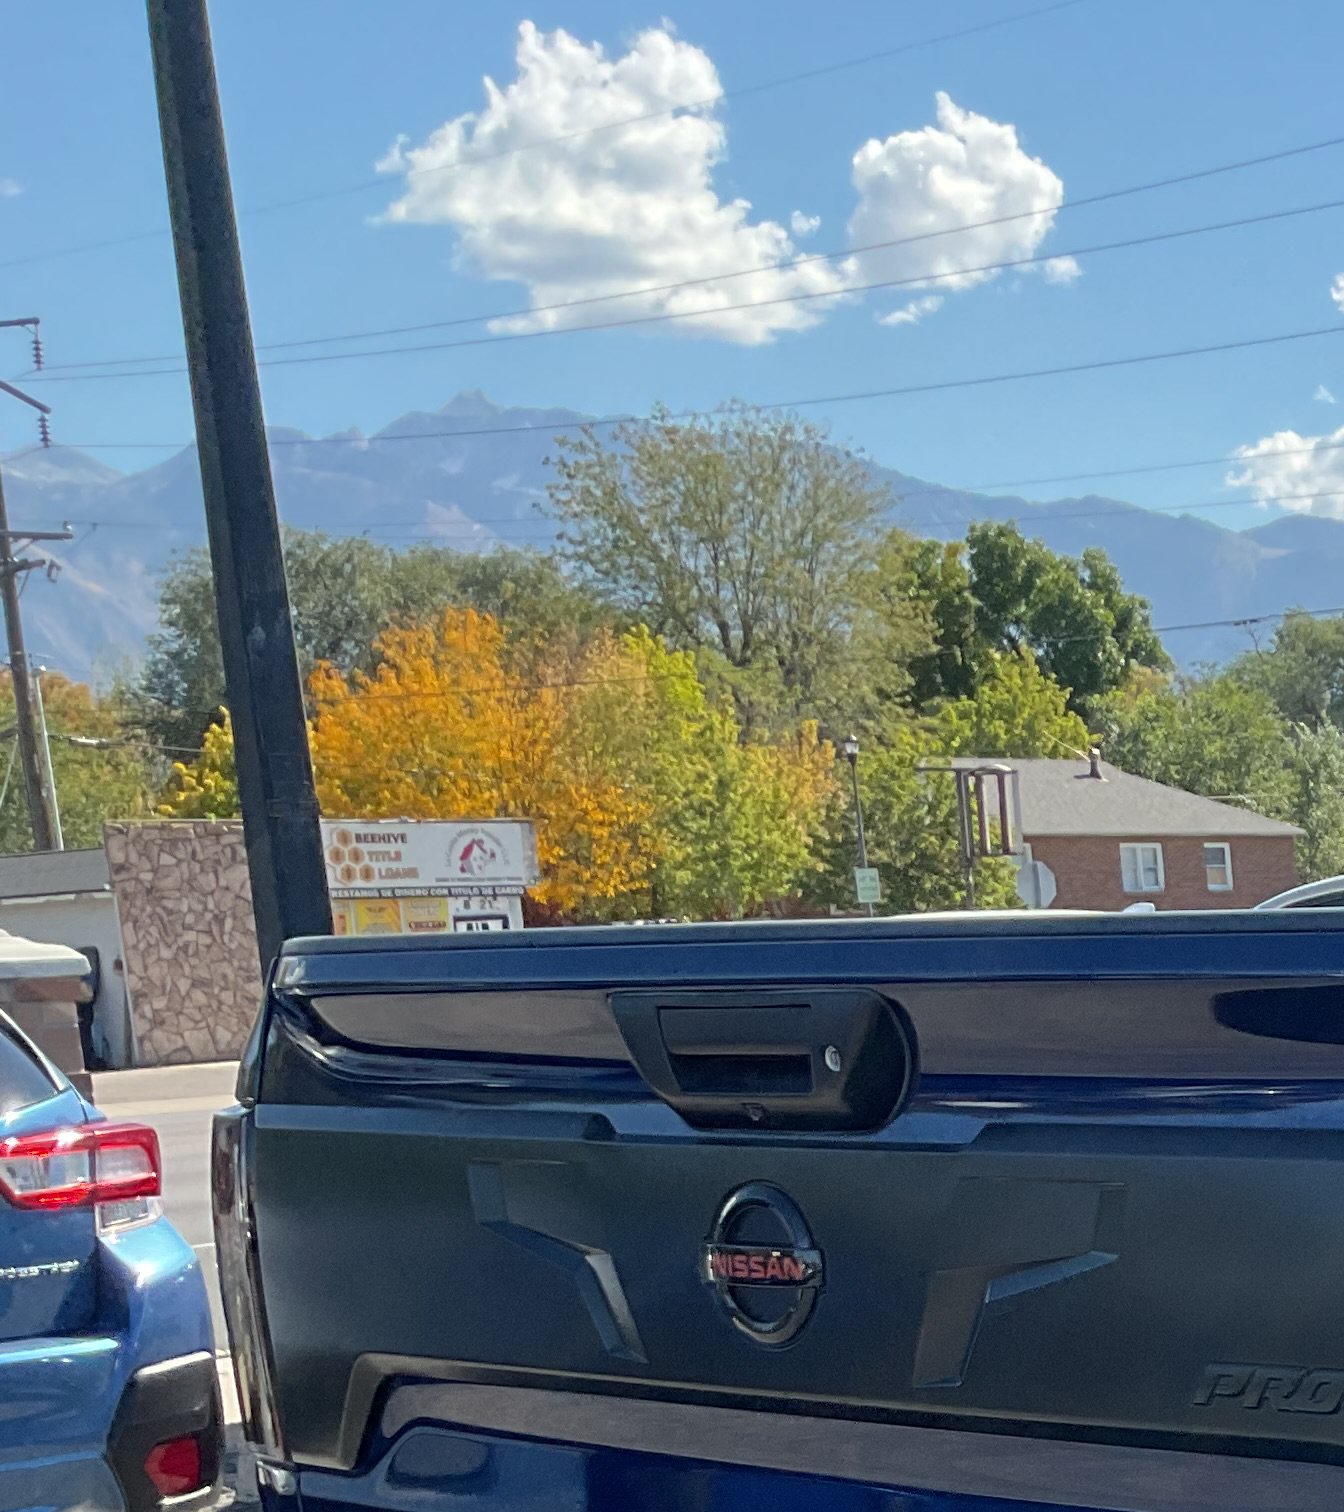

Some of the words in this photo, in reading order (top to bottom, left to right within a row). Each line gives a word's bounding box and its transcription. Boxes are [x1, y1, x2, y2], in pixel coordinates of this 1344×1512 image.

[354, 832, 407, 844] BEEHIVE
[331, 887, 379, 898] RESTAMOS
[712, 1252, 805, 1281] NISSAN
